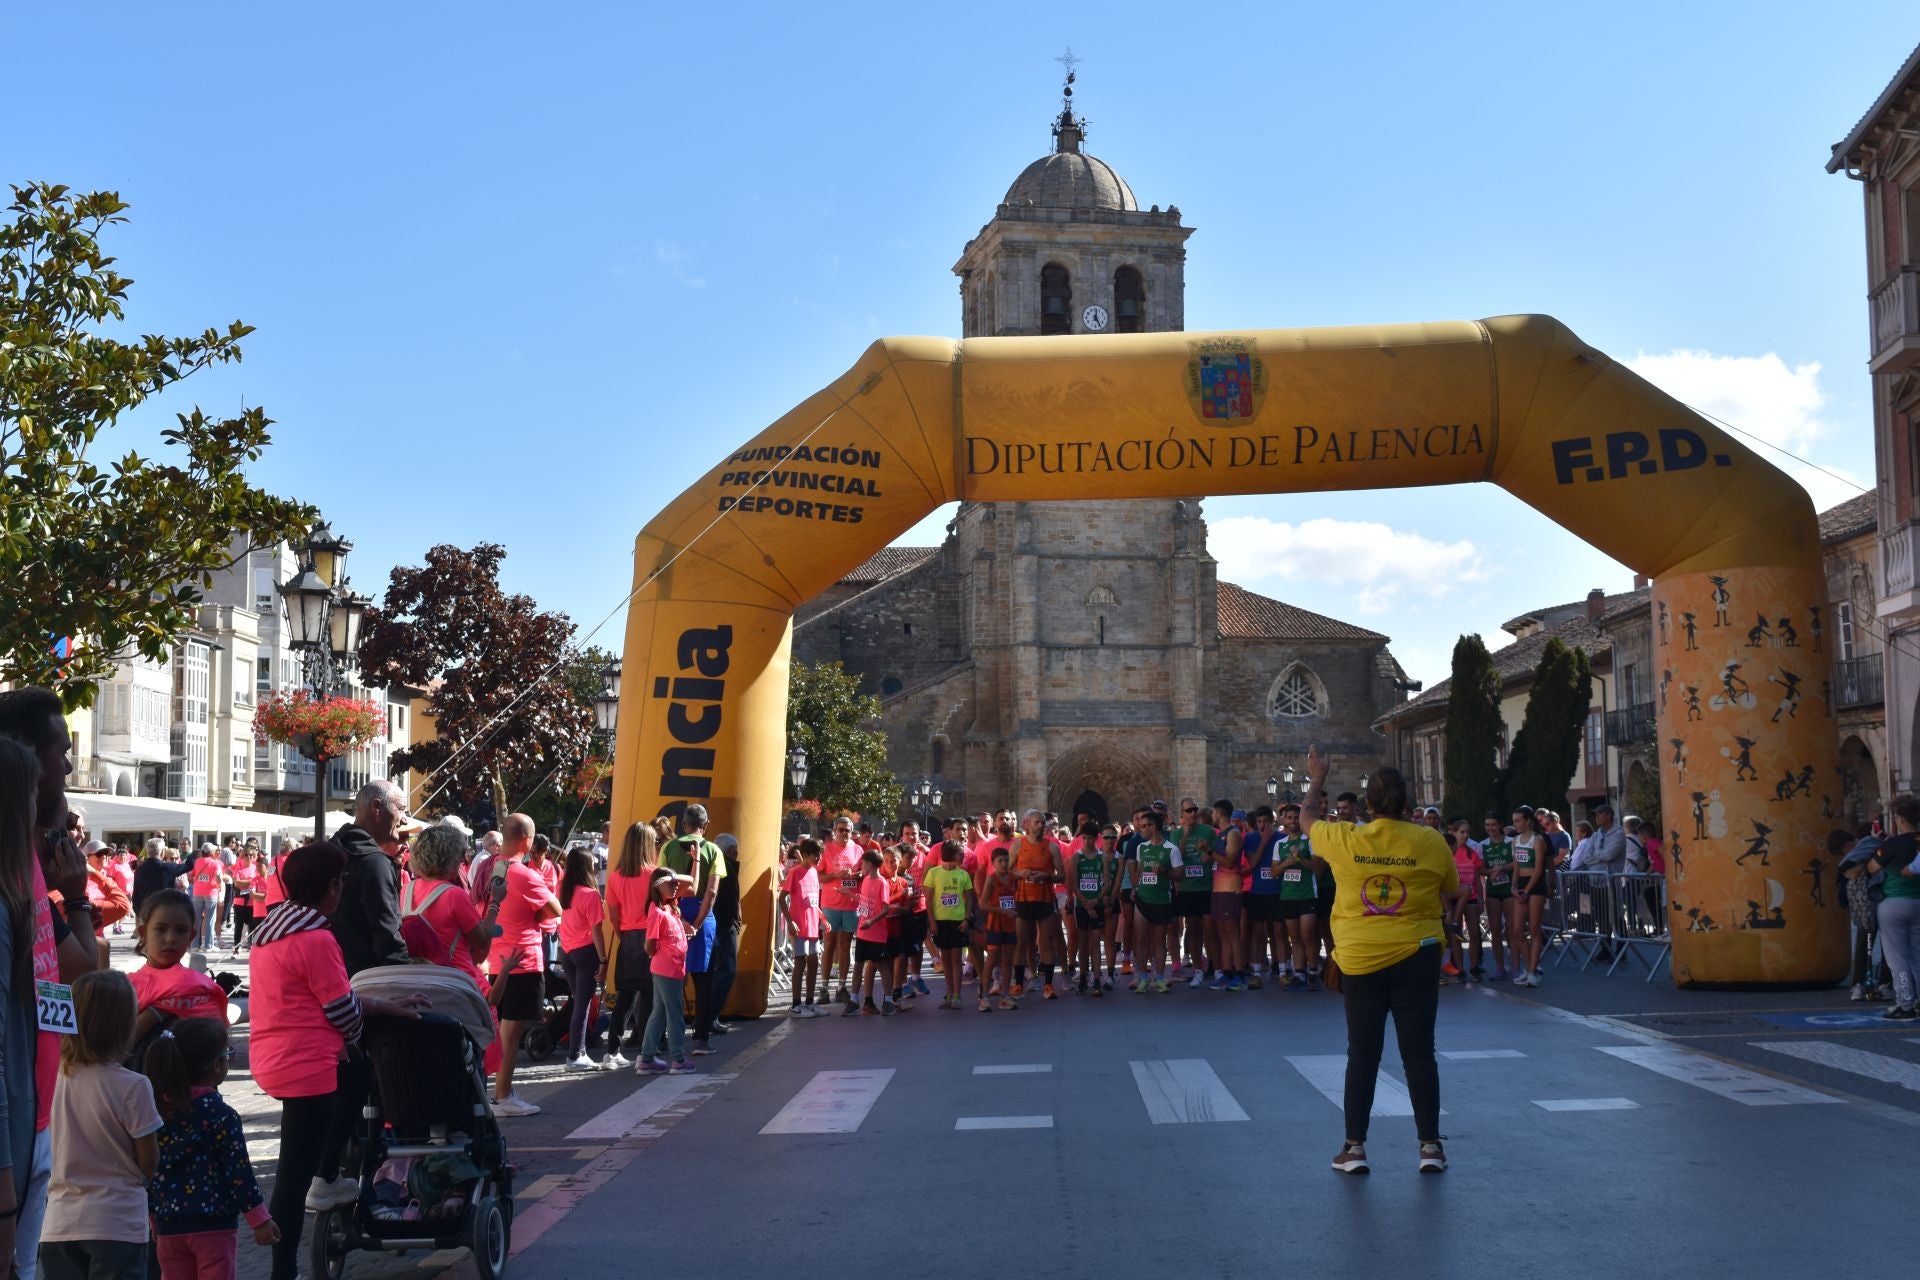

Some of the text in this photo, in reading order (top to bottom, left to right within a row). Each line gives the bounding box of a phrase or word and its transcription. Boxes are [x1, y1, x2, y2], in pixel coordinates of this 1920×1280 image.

[727, 443, 881, 469] FUNDACIÓN
[965, 423, 1485, 476] DIPUTACIÓN DE PALENCIA
[1551, 428, 1732, 485] F.P.D.
[718, 470, 882, 498] PROVINCIAL
[717, 495, 864, 524] DEPORTES
[1354, 855, 1417, 867] ORGANIZACIÓN
[38, 998, 74, 1028] 222
